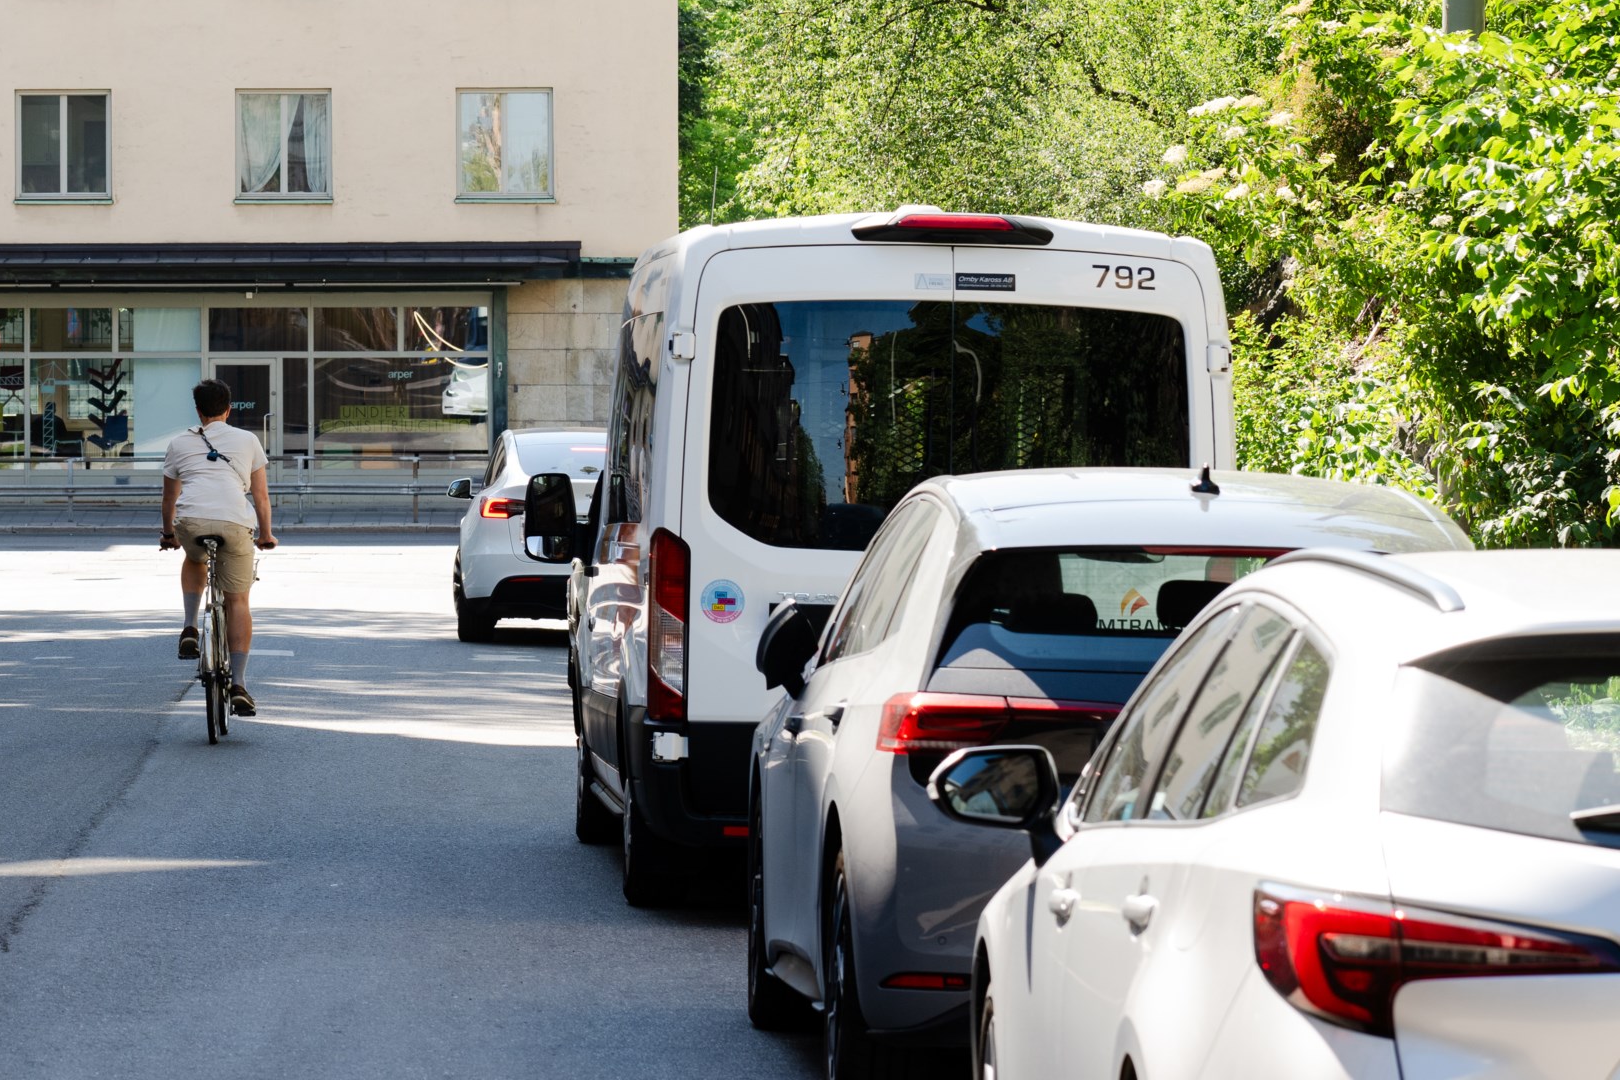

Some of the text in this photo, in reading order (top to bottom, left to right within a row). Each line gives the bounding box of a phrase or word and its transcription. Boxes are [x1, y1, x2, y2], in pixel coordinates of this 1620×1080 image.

[1092, 264, 1156, 291] 792
[387, 370, 414, 381] arper
[230, 400, 256, 411] arper
[341, 406, 407, 419] UNDER
